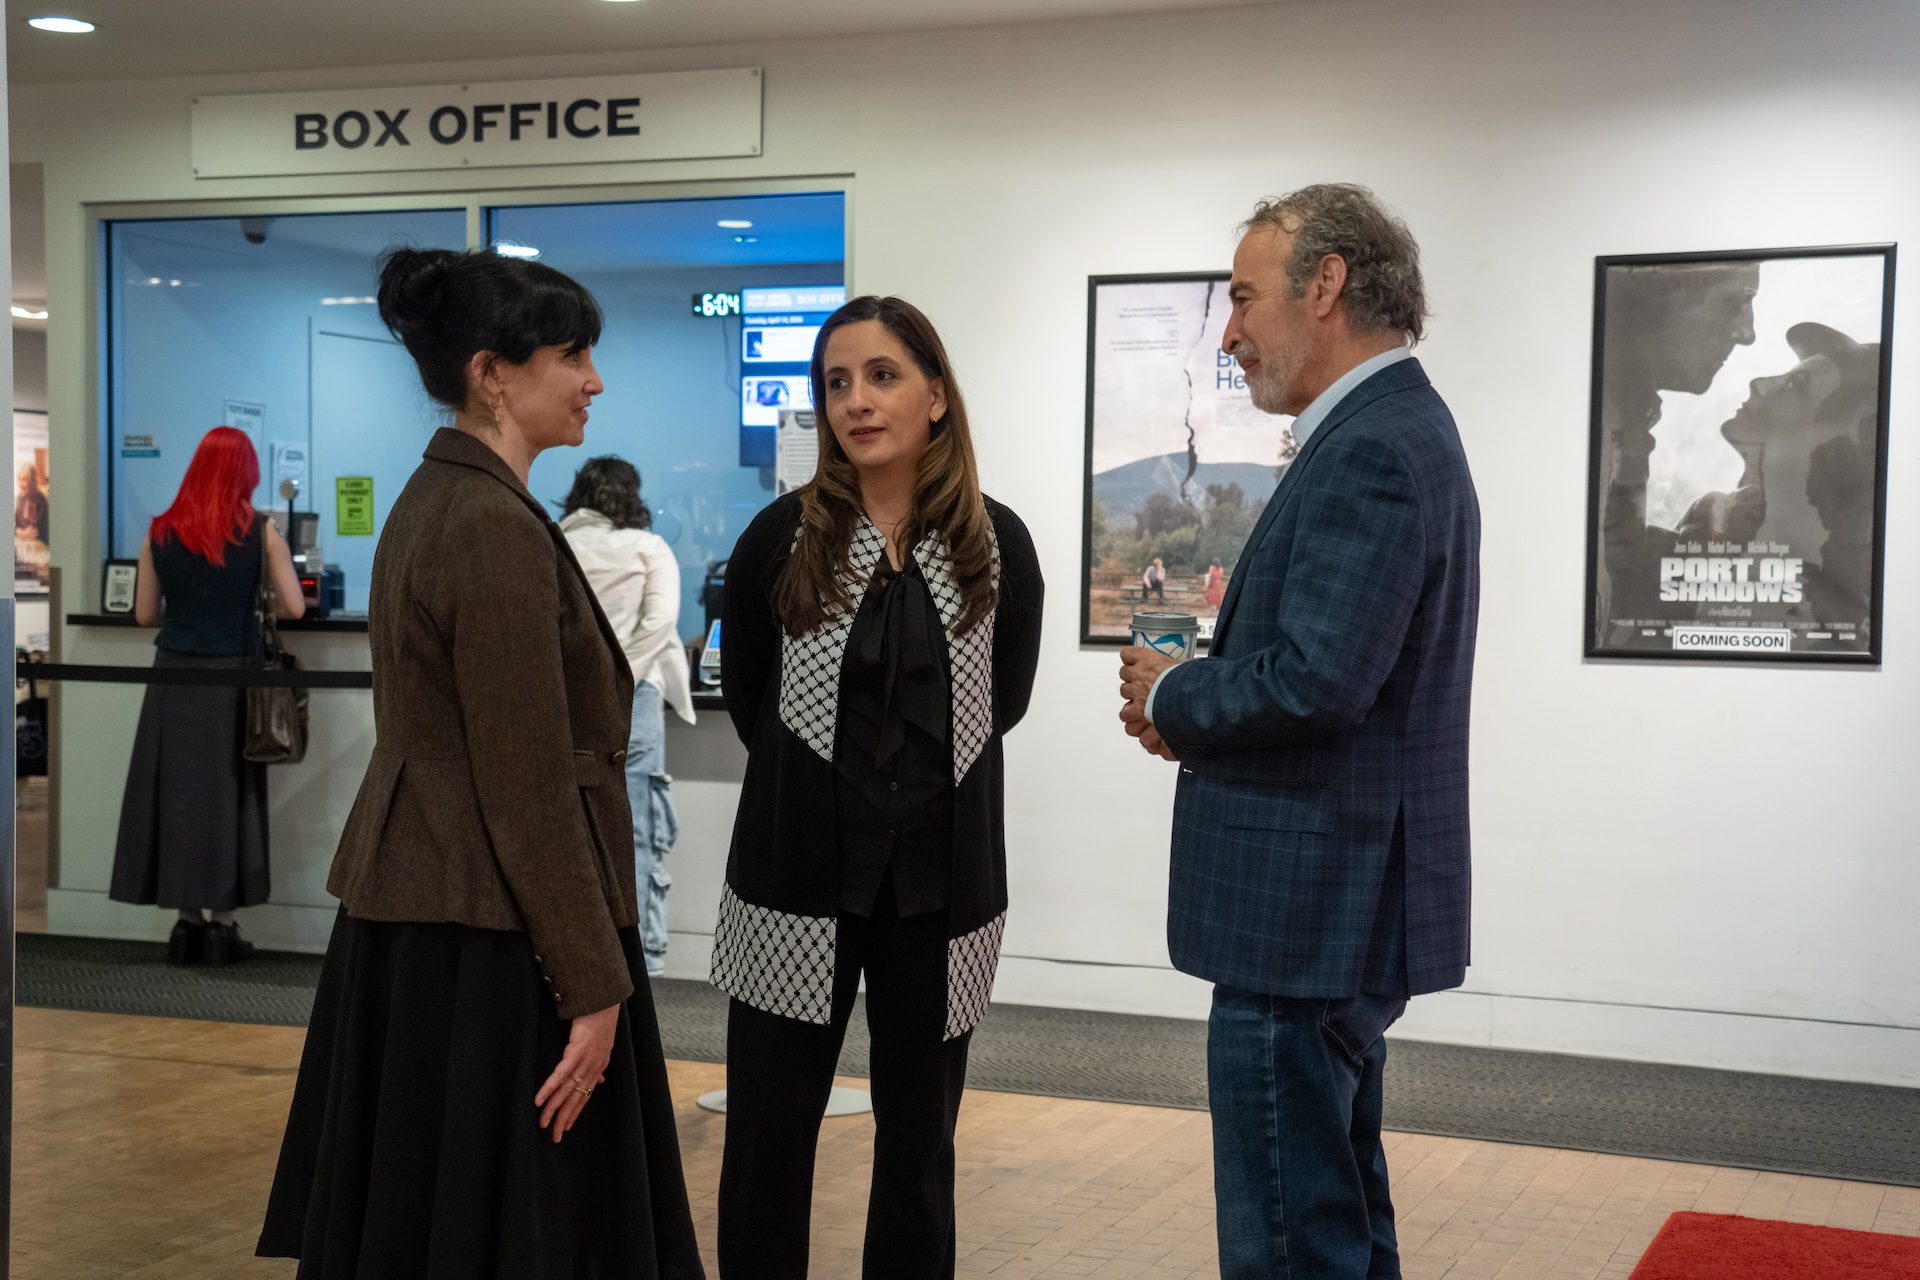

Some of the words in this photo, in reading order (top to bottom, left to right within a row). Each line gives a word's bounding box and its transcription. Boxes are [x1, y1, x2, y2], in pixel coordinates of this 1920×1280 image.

[295, 109, 411, 150] BOX
[429, 98, 641, 145] OFFICE
[702, 293, 740, 317] 6:04
[1661, 557, 1754, 582] PORT
[1760, 558, 1803, 583] OF
[1660, 581, 1802, 603] SHADOWS
[1680, 634, 1740, 646] COMING
[1743, 635, 1784, 648] SOON
